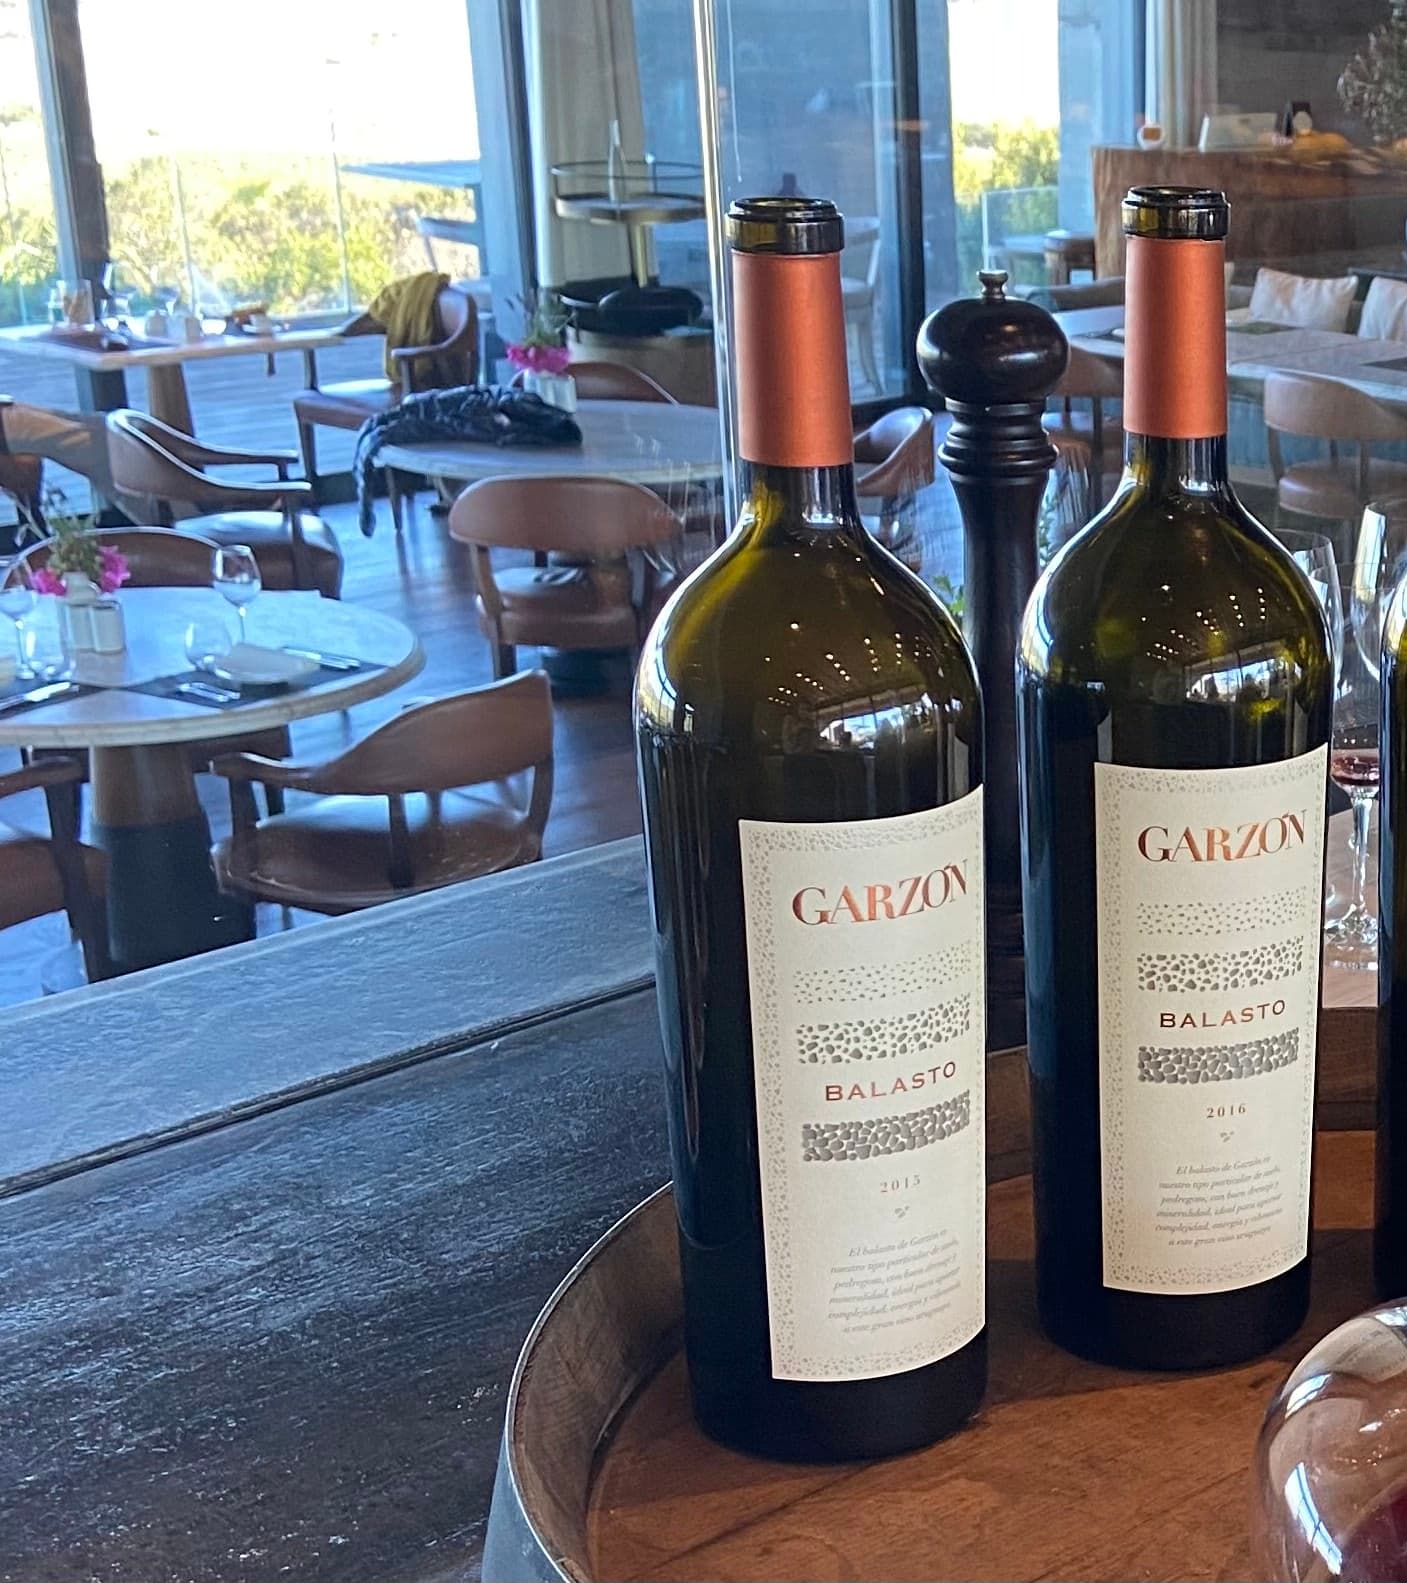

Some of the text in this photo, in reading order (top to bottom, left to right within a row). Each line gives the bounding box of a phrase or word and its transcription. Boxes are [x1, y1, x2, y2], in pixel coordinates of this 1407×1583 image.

[1137, 808, 1308, 863] GARZÓN
[791, 858, 969, 926] GARZÓN
[1159, 999, 1287, 1030] BALASTO
[824, 1061, 957, 1102] BALASTO
[1206, 1102, 1247, 1119] 2016
[880, 1174, 921, 1194] 2015
